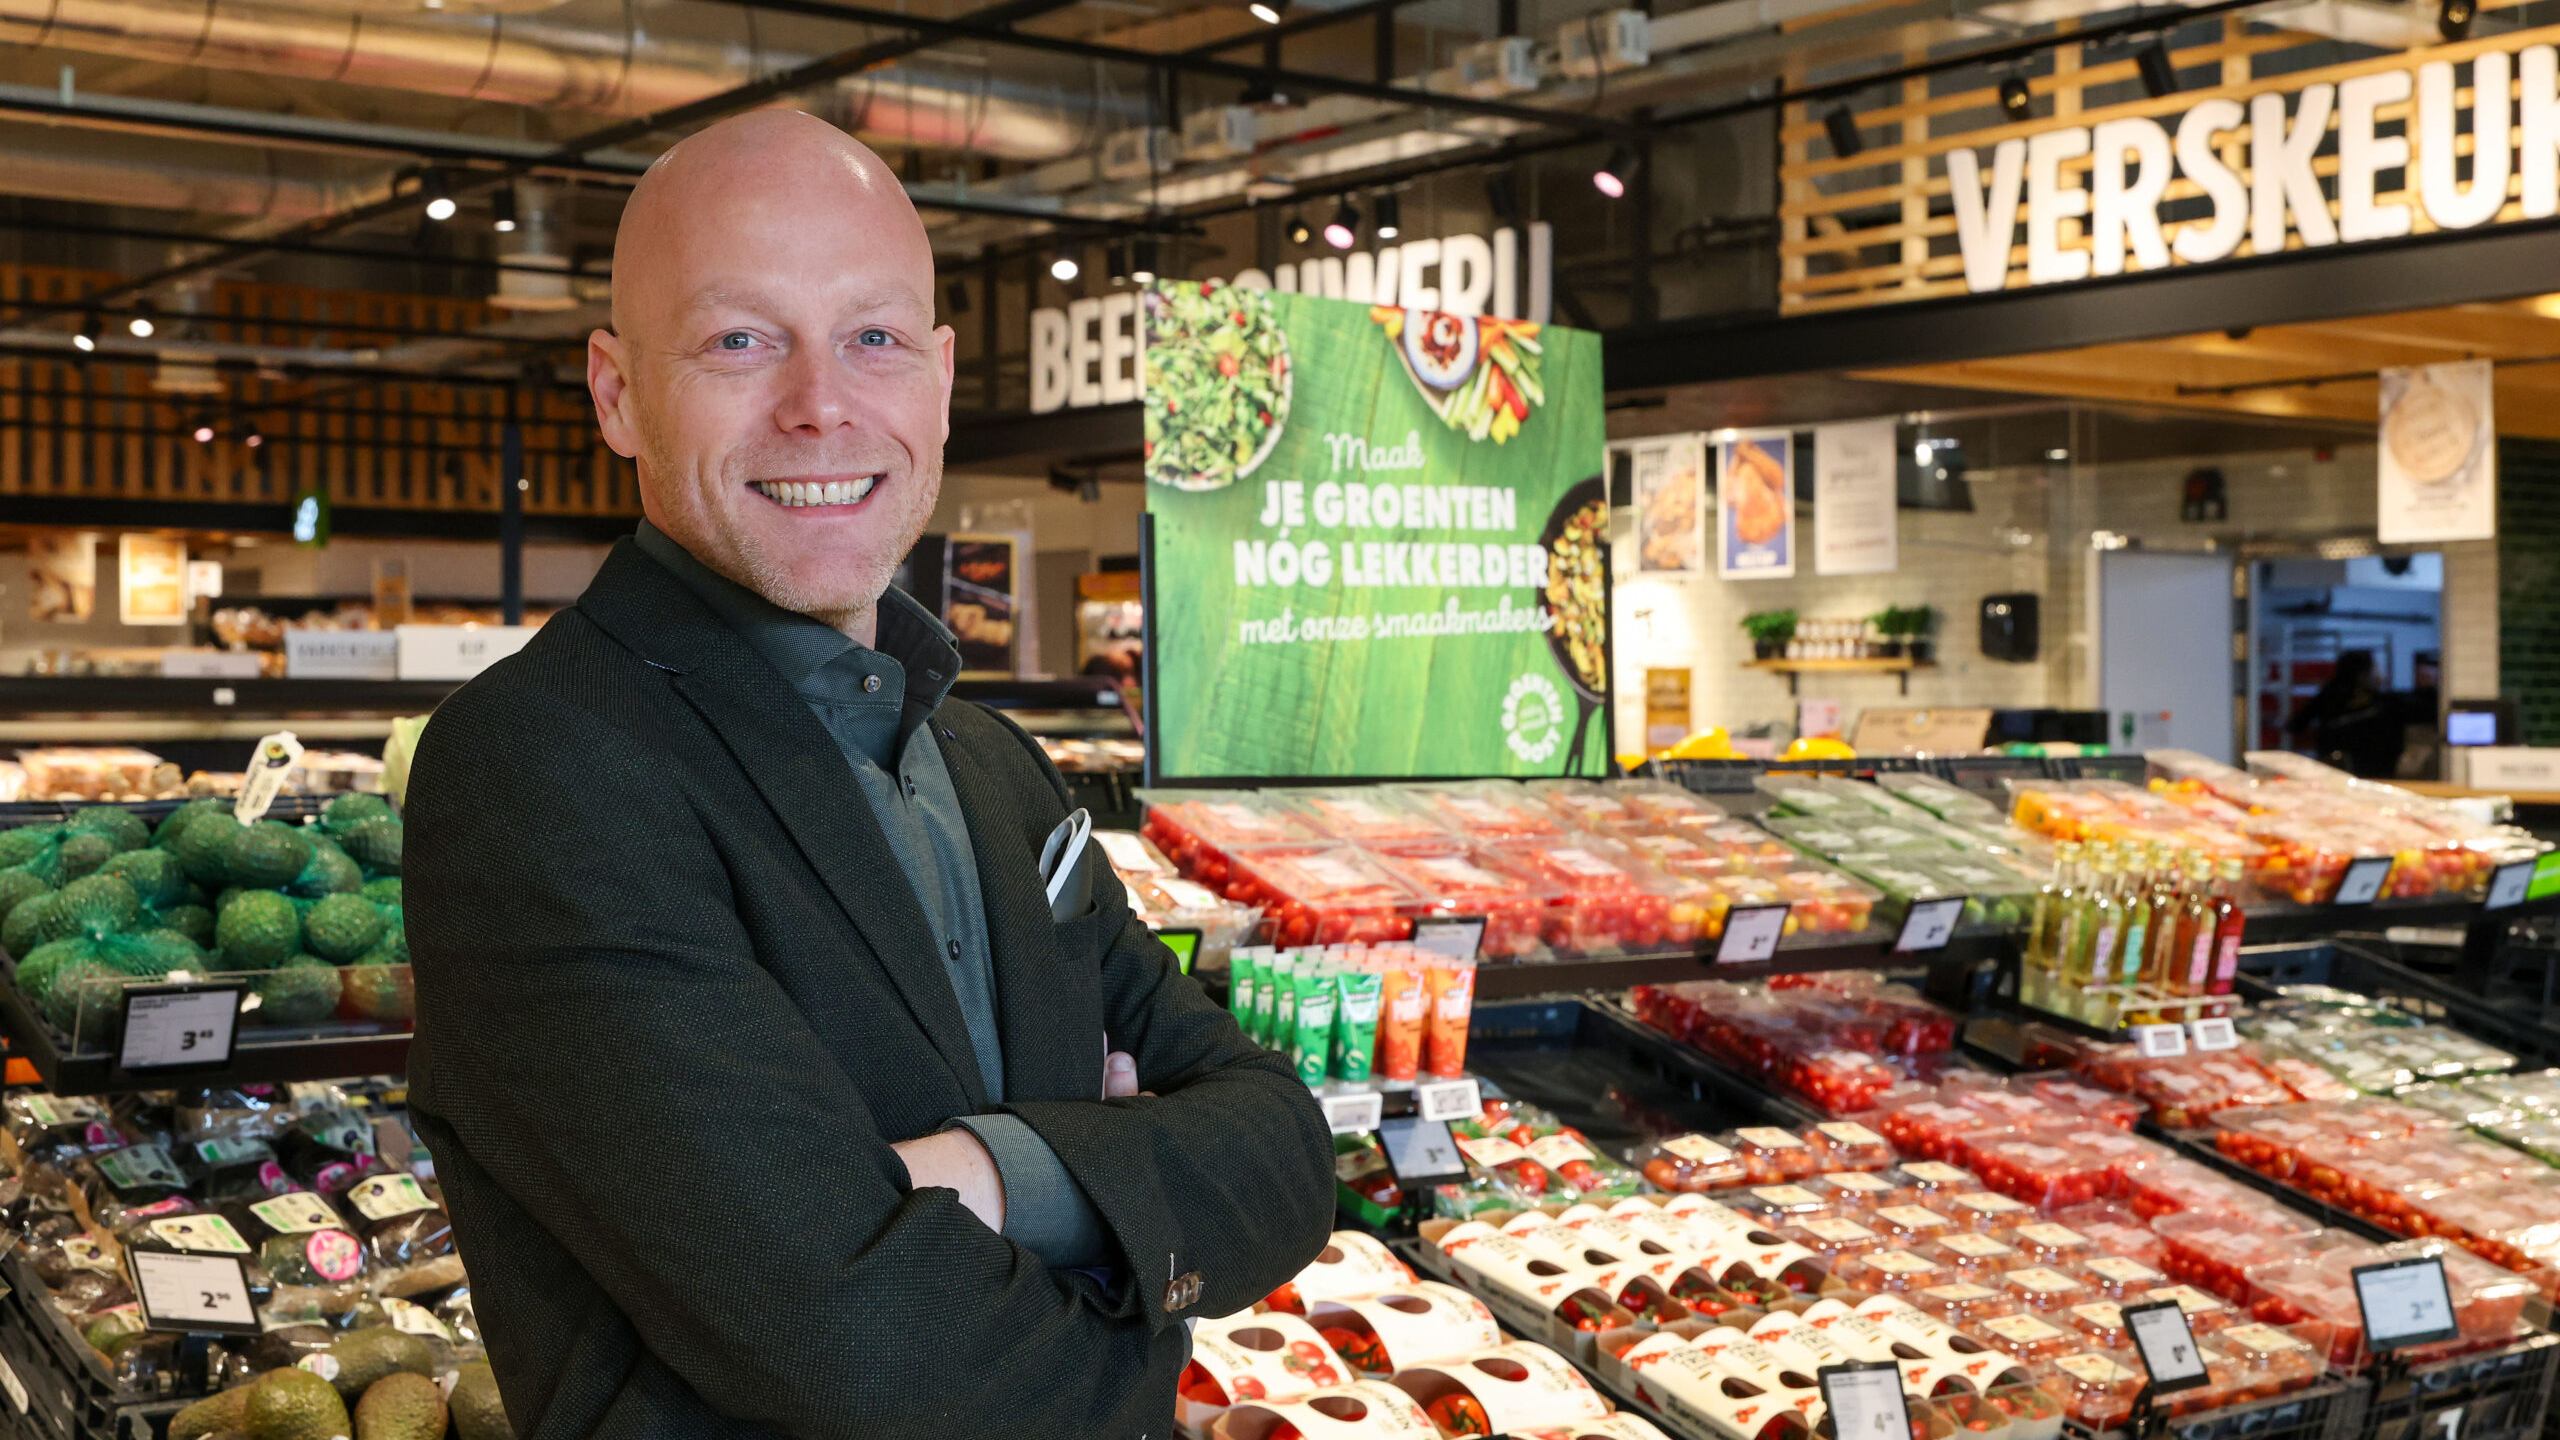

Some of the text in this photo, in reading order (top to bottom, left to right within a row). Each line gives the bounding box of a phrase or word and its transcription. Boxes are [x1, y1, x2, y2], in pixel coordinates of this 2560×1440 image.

[1324, 431, 1427, 474] Maak
[1260, 479, 1516, 532] JE GROENTEN
[1233, 528, 1549, 589] NÓG LEKKERDER
[1239, 594, 1556, 645] met onze smaakmakers
